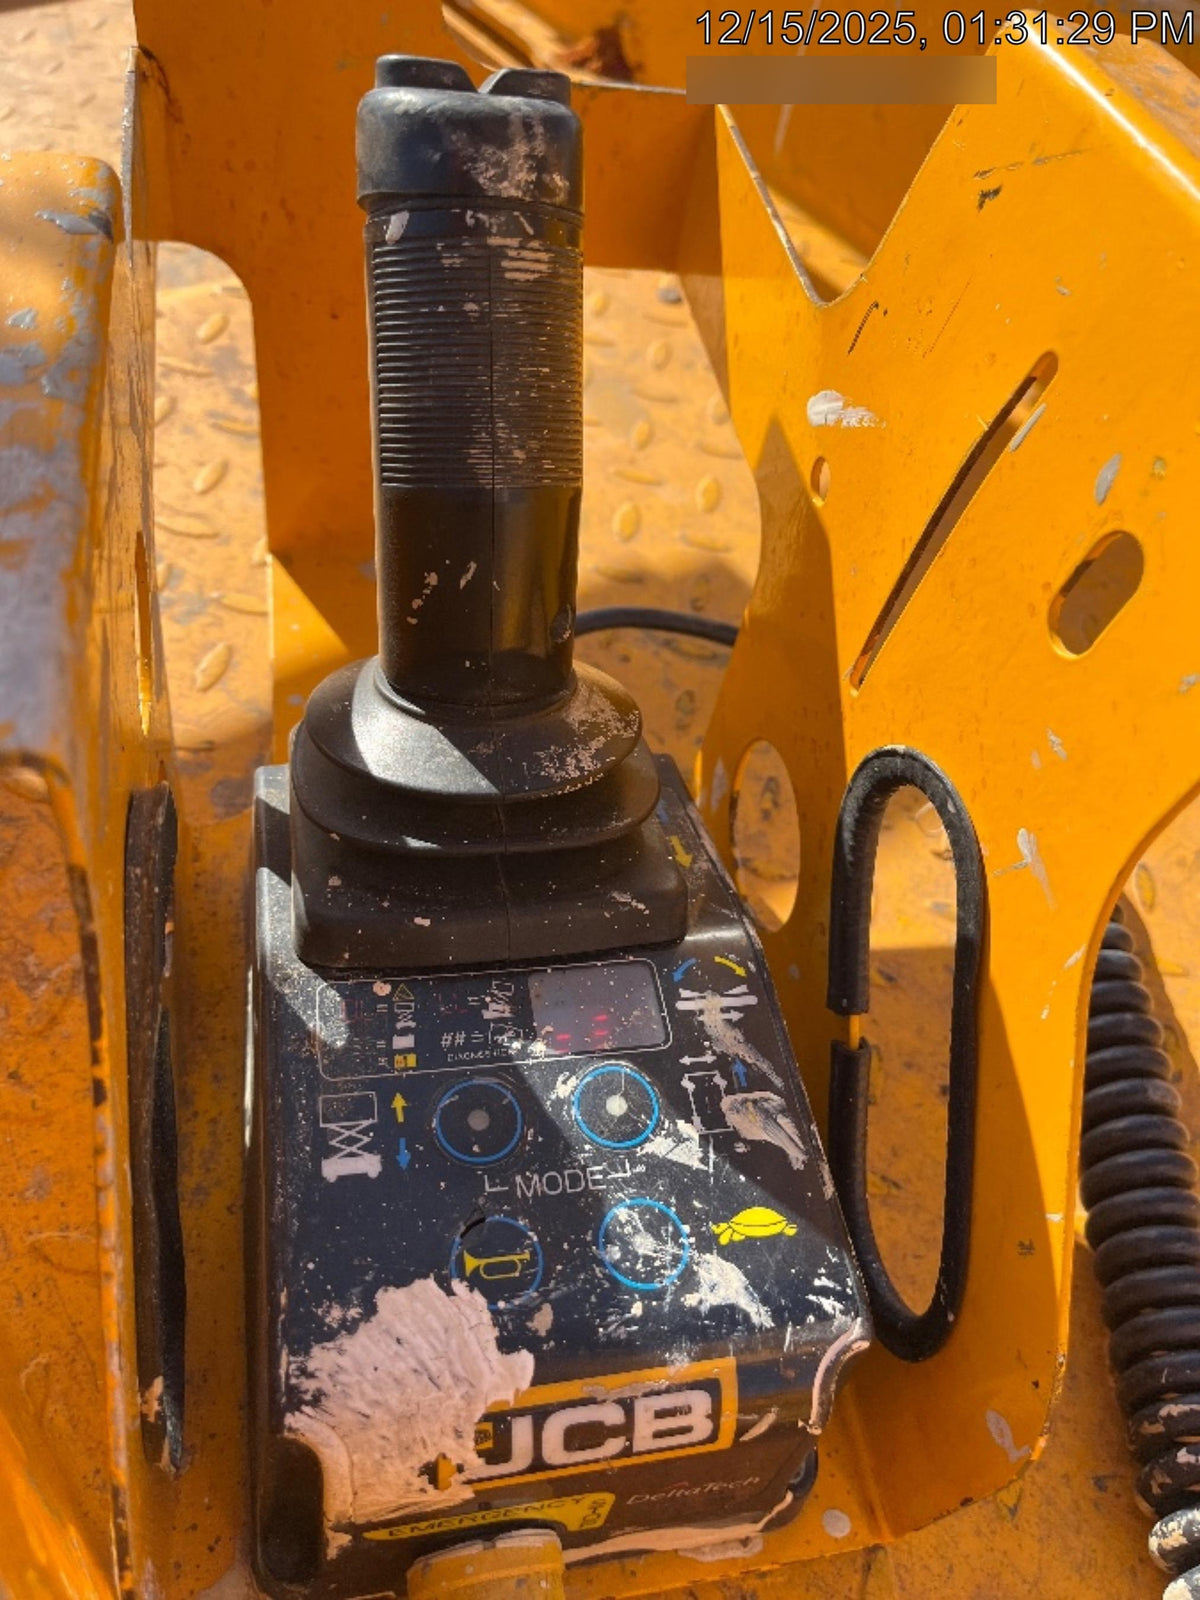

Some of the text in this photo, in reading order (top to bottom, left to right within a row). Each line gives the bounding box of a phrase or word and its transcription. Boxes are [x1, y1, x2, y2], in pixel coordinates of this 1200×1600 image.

[515, 1165, 607, 1199] MODE
[465, 1389, 714, 1480] JCB
[388, 1498, 586, 1537] EMERGENCY
